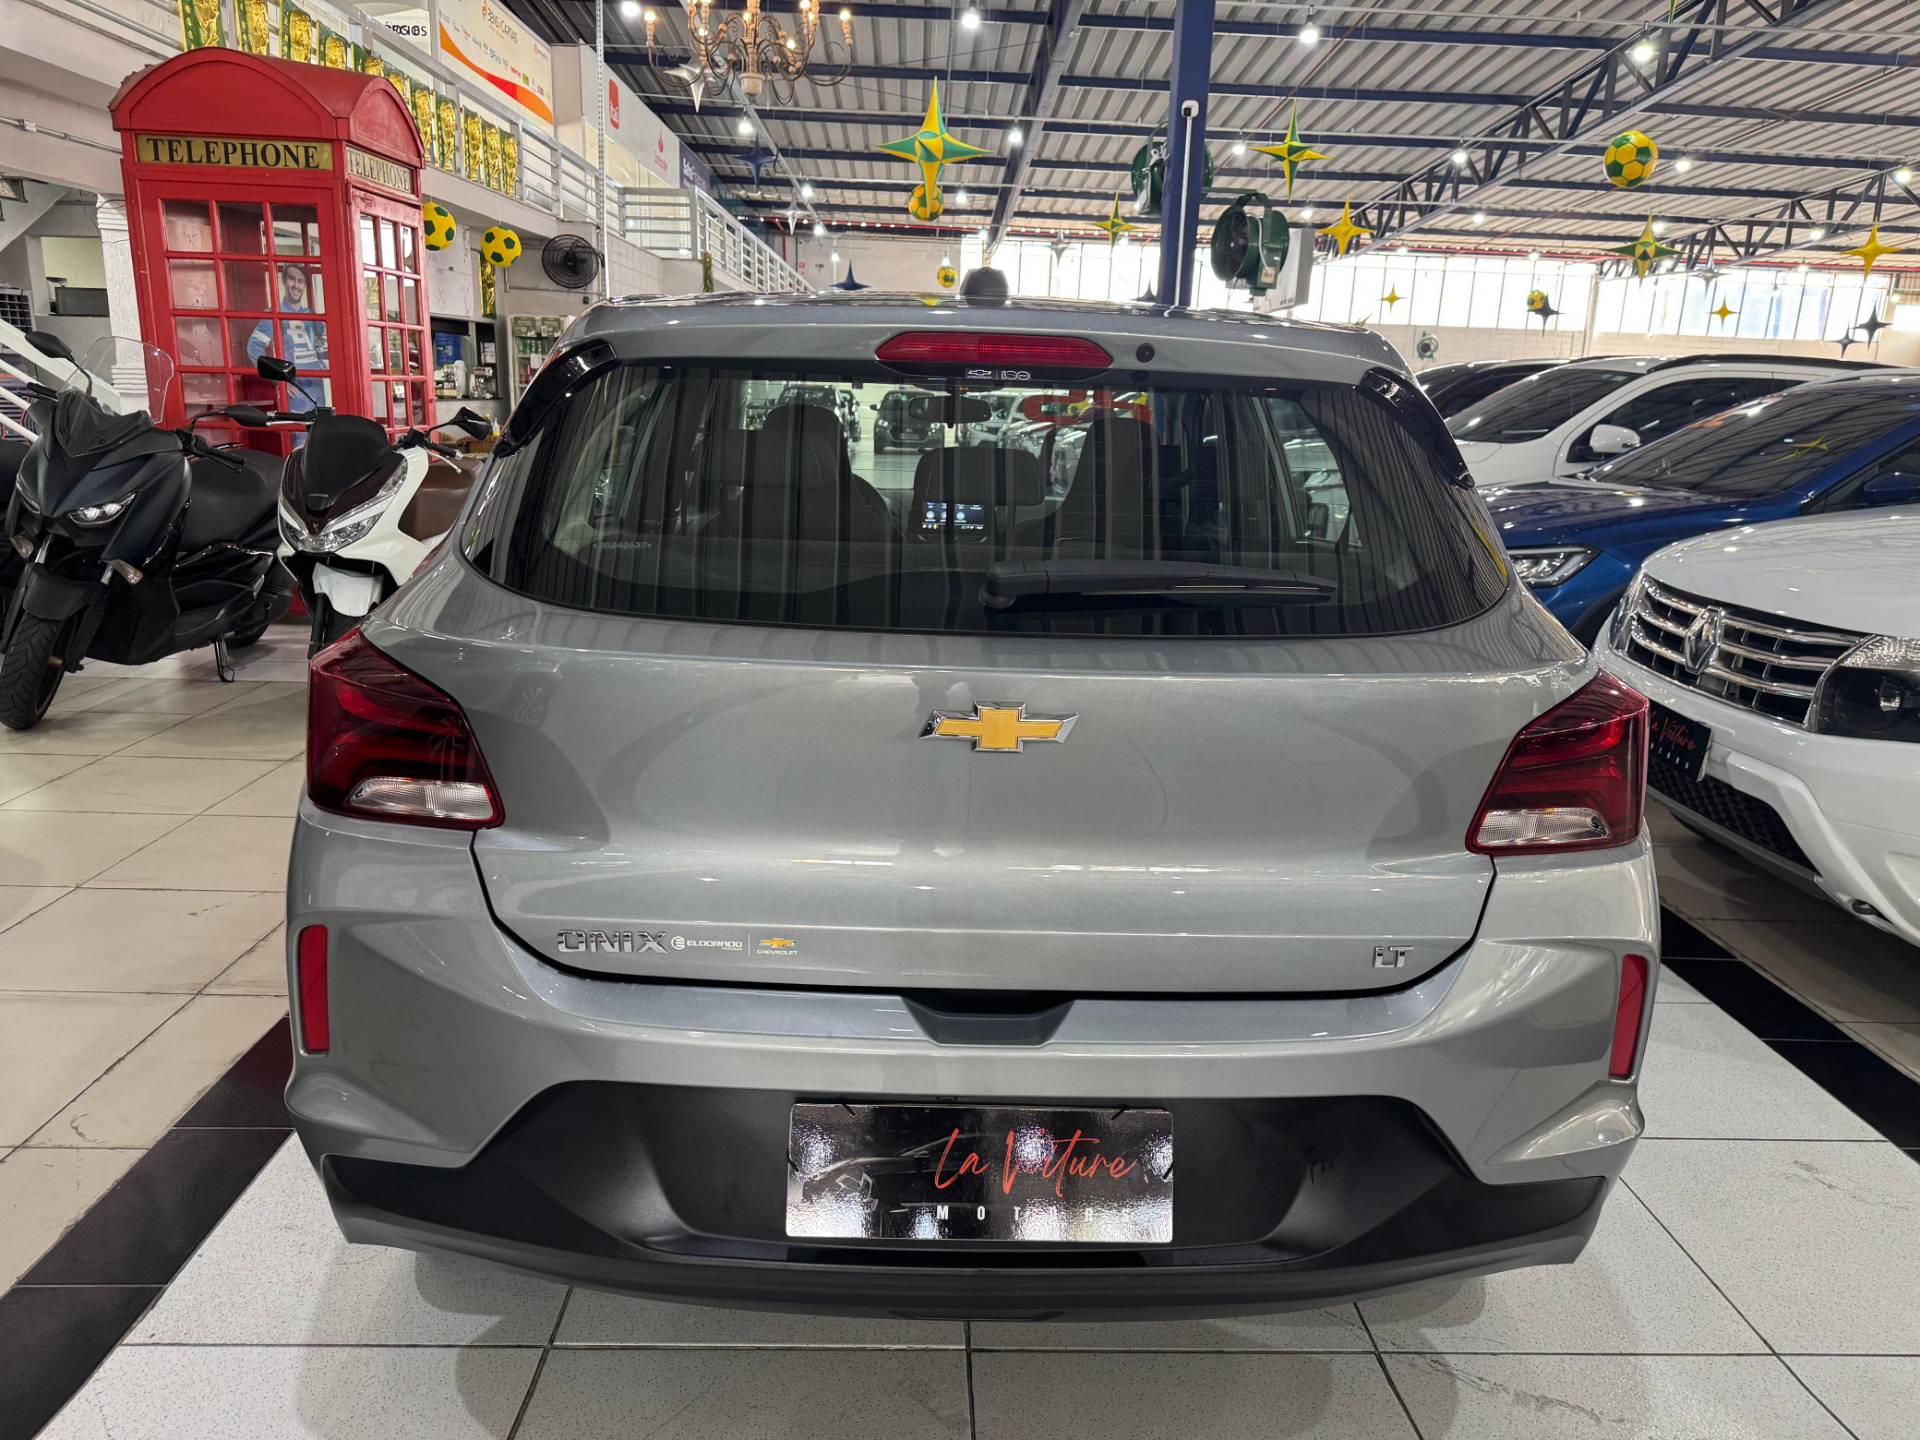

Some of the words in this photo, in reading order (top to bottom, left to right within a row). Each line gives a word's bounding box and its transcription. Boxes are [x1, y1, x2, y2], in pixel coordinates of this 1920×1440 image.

[146, 138, 320, 169] TELEPHONE
[347, 150, 411, 192] TELEPHONE
[558, 929, 669, 954] ONIX
[1373, 945, 1415, 969] LT
[934, 1127, 989, 1189] La
[1002, 1127, 1138, 1199] Viture
